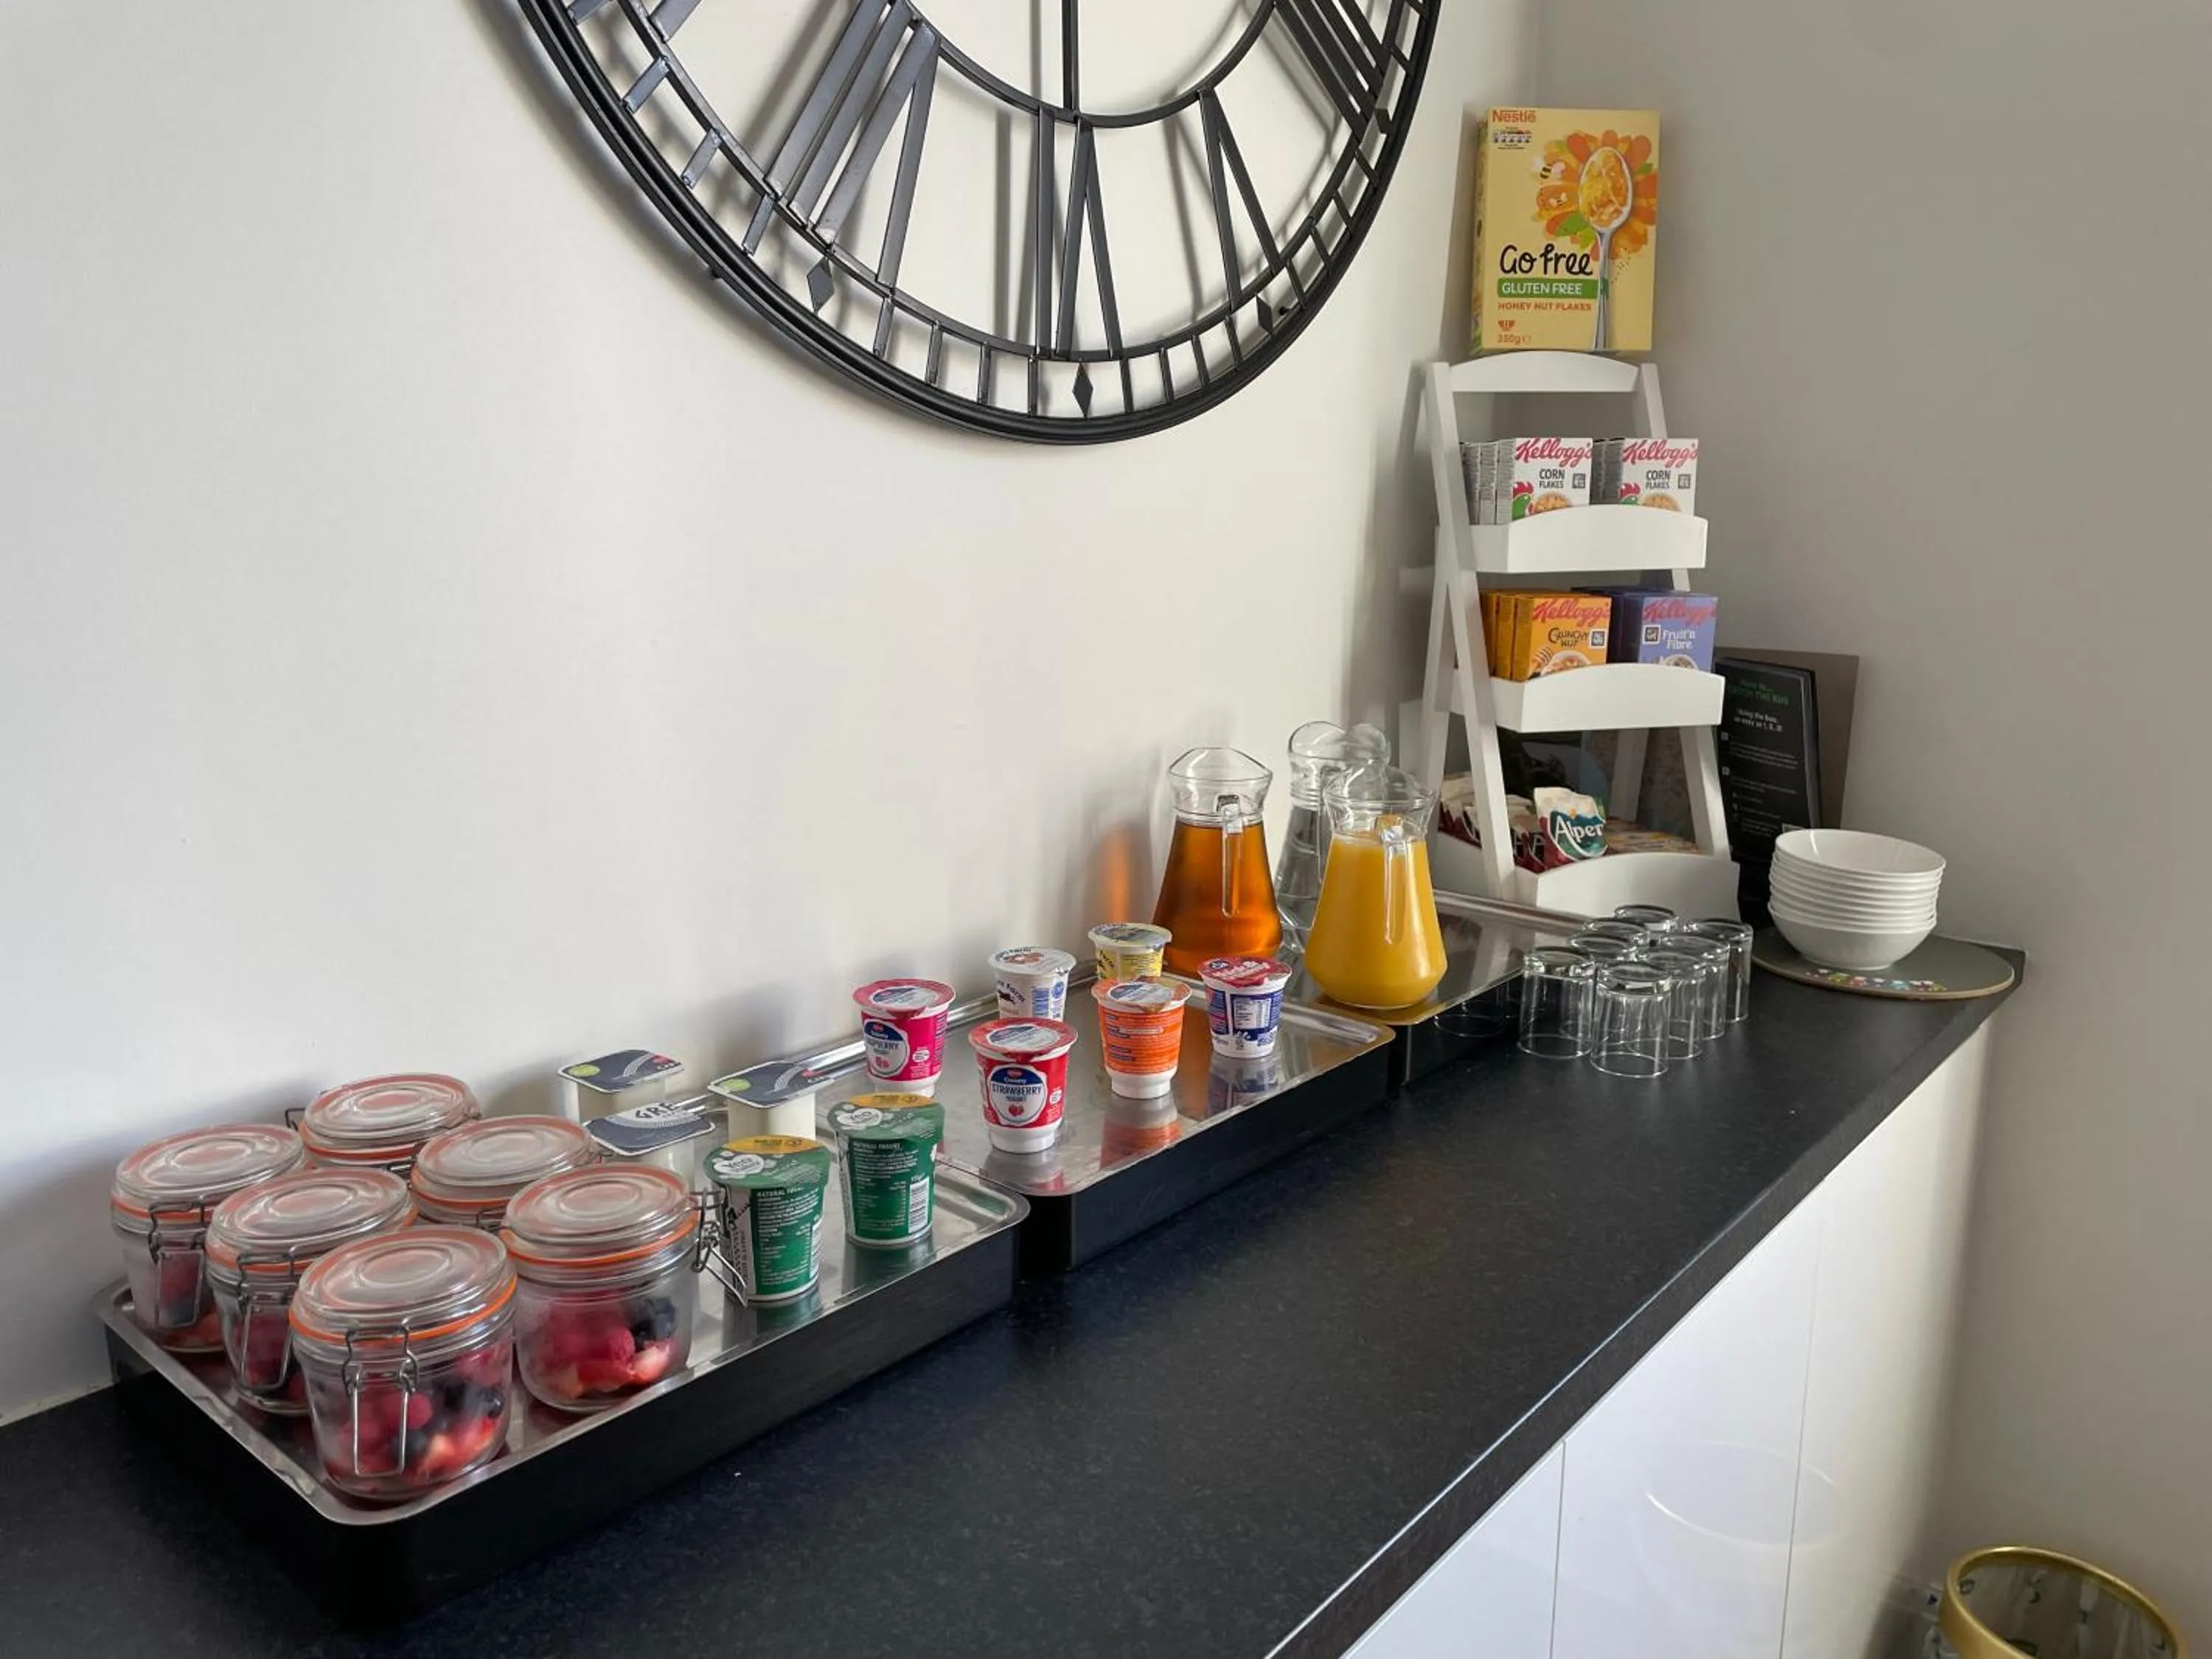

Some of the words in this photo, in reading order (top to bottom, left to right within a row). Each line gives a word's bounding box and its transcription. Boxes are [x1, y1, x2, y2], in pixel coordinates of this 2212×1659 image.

[1500, 244, 1537, 274] Go
[1540, 243, 1593, 276] free
[1501, 282, 1550, 294] GLUTEN
[1552, 282, 1582, 295] FREE
[1498, 301, 1531, 310] HONEY
[1534, 302, 1552, 310] NUT
[1555, 302, 1592, 311] FLAKES
[1515, 437, 1593, 467] Kellogg's
[1621, 439, 1699, 467] Kellogg's
[1539, 468, 1565, 479] CORN
[1646, 470, 1671, 481] CORN
[1645, 481, 1670, 490] FLAKES
[1532, 597, 1610, 627] Kellogg's
[992, 1084, 1042, 1096] STRAWBERRY
